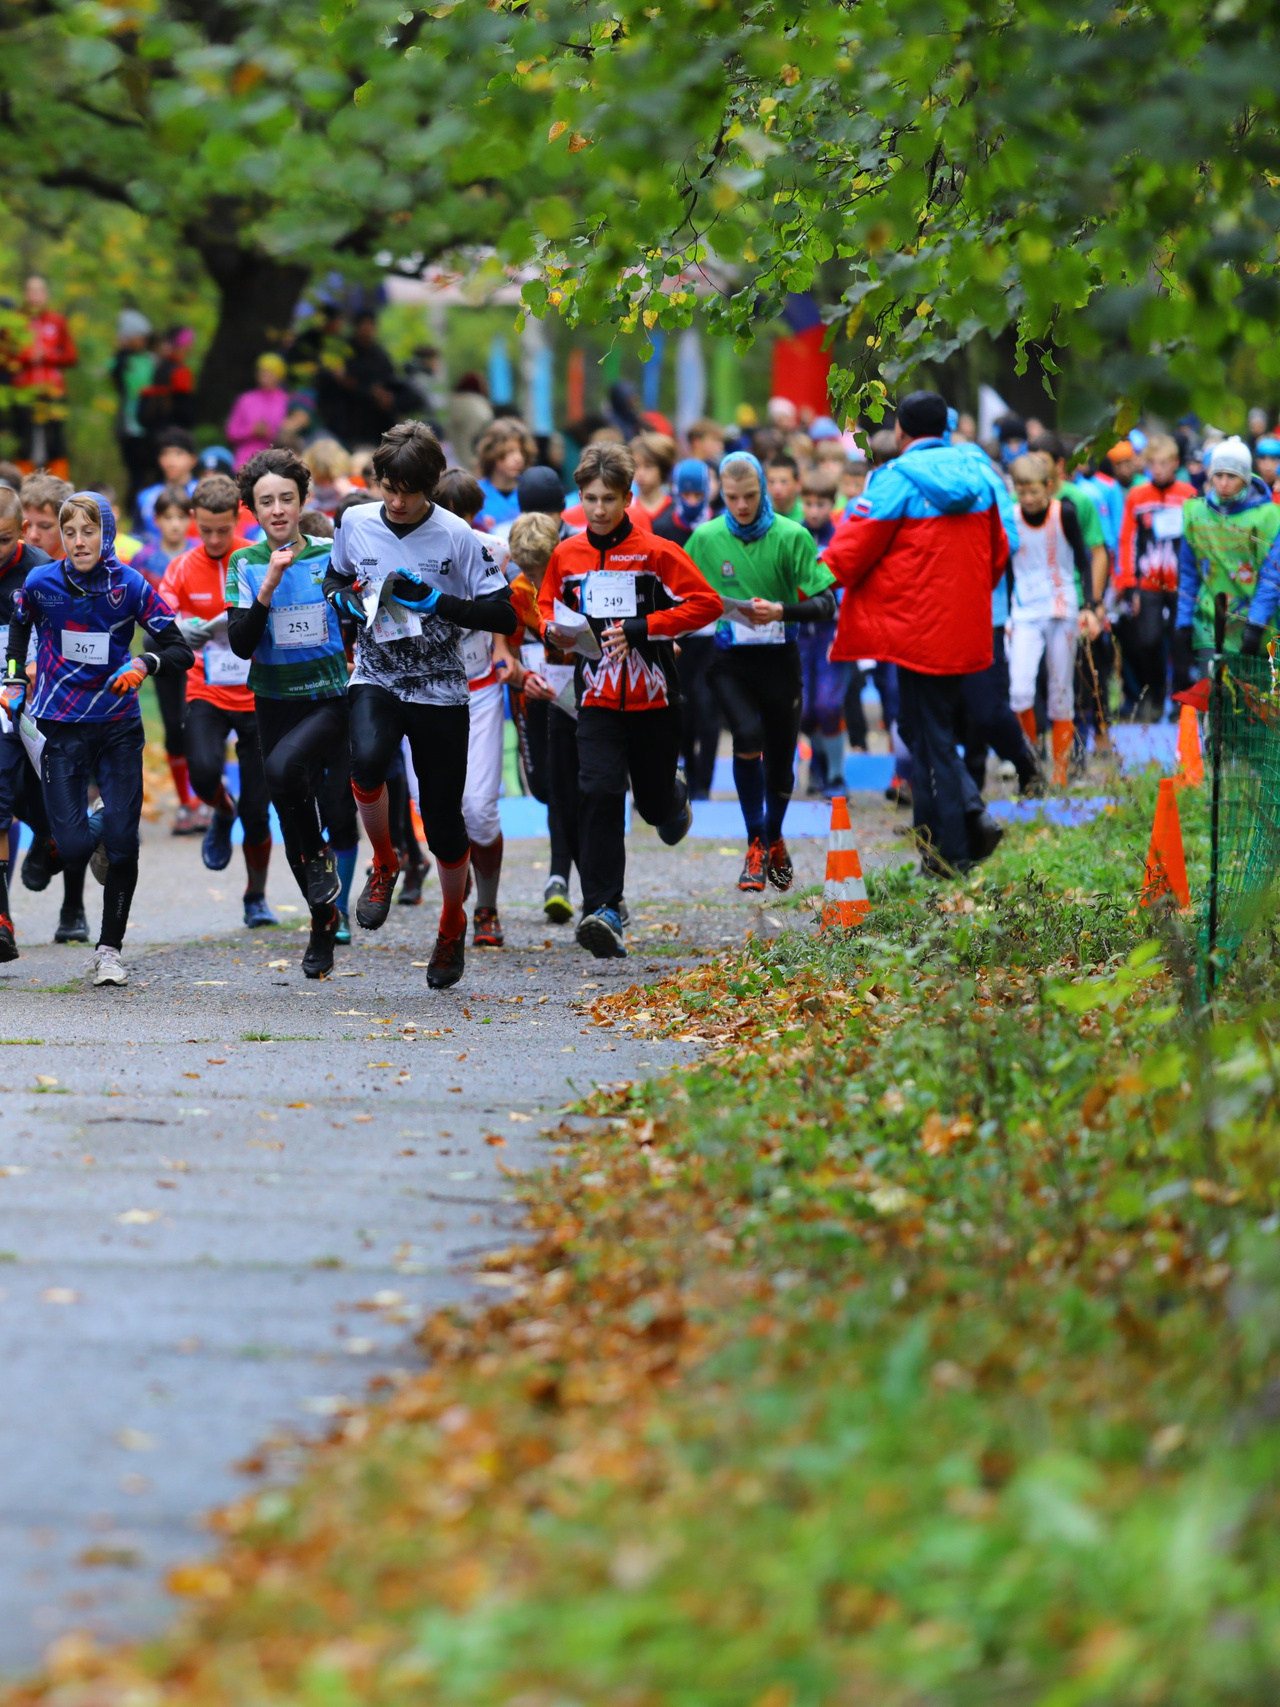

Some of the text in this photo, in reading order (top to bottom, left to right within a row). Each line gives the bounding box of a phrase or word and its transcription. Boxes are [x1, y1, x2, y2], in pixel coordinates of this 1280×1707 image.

[604, 597, 623, 607] 249
[288, 622, 310, 633] 253
[75, 642, 96, 654] 267
